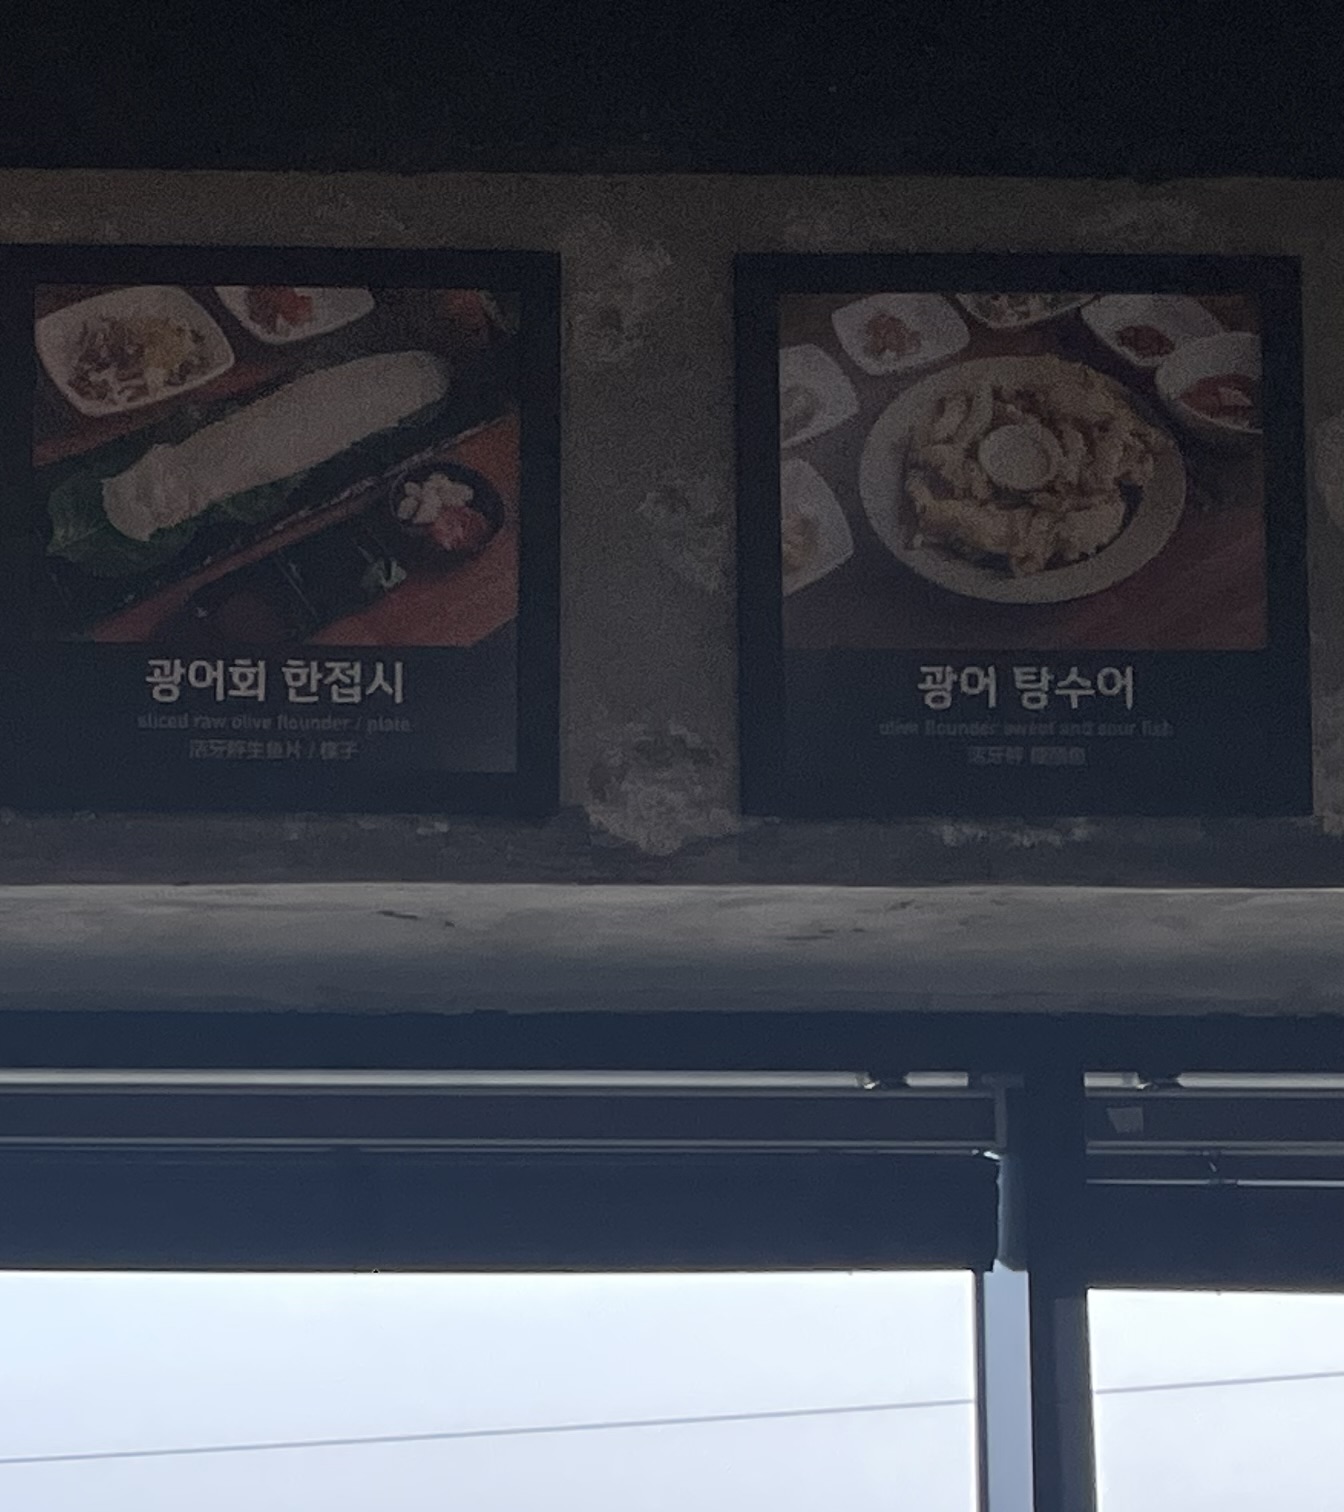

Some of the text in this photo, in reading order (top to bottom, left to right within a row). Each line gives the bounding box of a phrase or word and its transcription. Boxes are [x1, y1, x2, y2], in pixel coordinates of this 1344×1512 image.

[145, 658, 404, 704] 광어회 한접시
[916, 664, 1134, 710] 광어 탕수어
[192, 715, 227, 729] raw
[231, 713, 272, 730] olive
[277, 713, 349, 731] flounder
